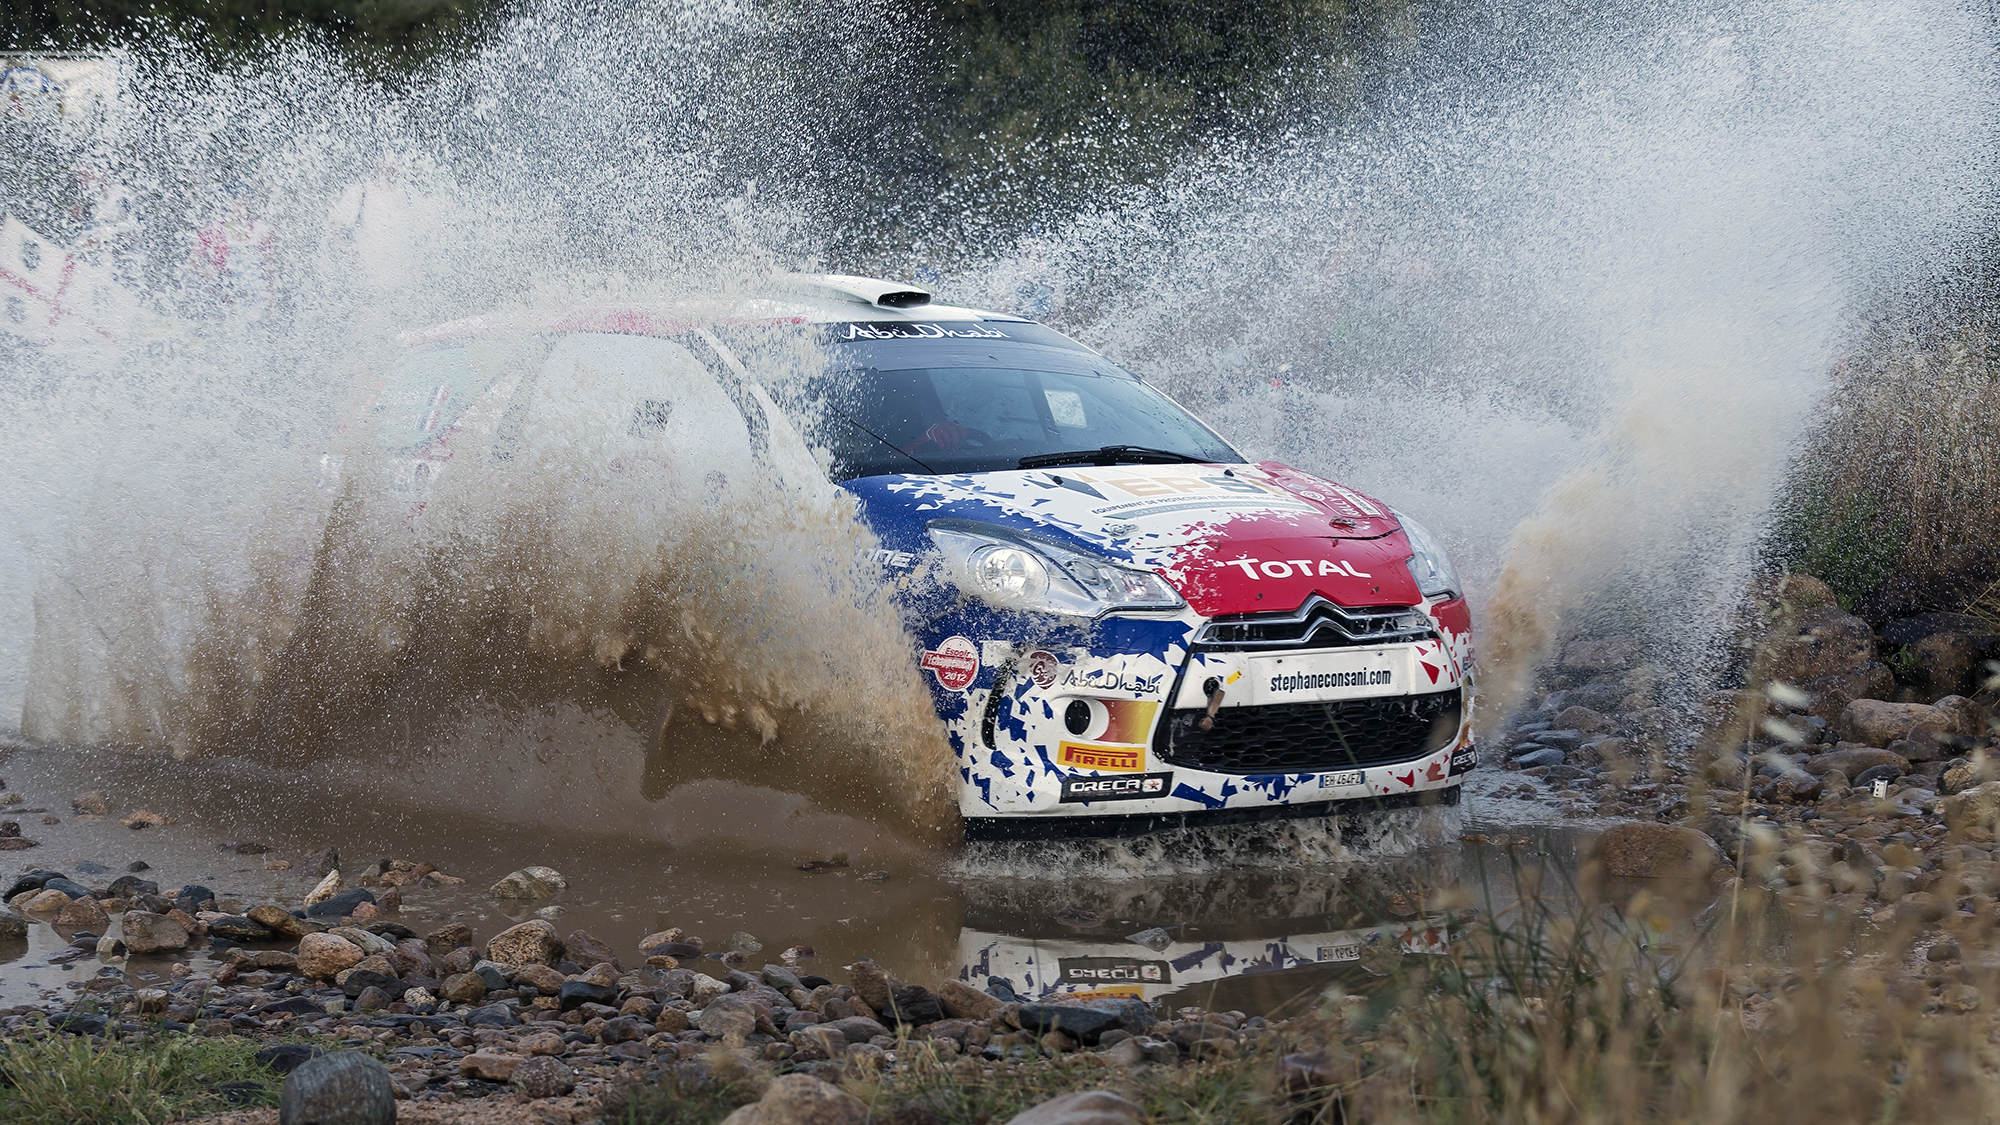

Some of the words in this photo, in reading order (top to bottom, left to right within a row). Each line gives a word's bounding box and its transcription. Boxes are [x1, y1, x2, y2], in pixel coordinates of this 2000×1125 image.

[1225, 558, 1372, 581] TOTAL
[944, 672, 967, 681] 2012
[1270, 667, 1391, 693] stephaneconsani.com
[1065, 746, 1138, 768] PIRELLI
[1070, 780, 1141, 792] ORECA
